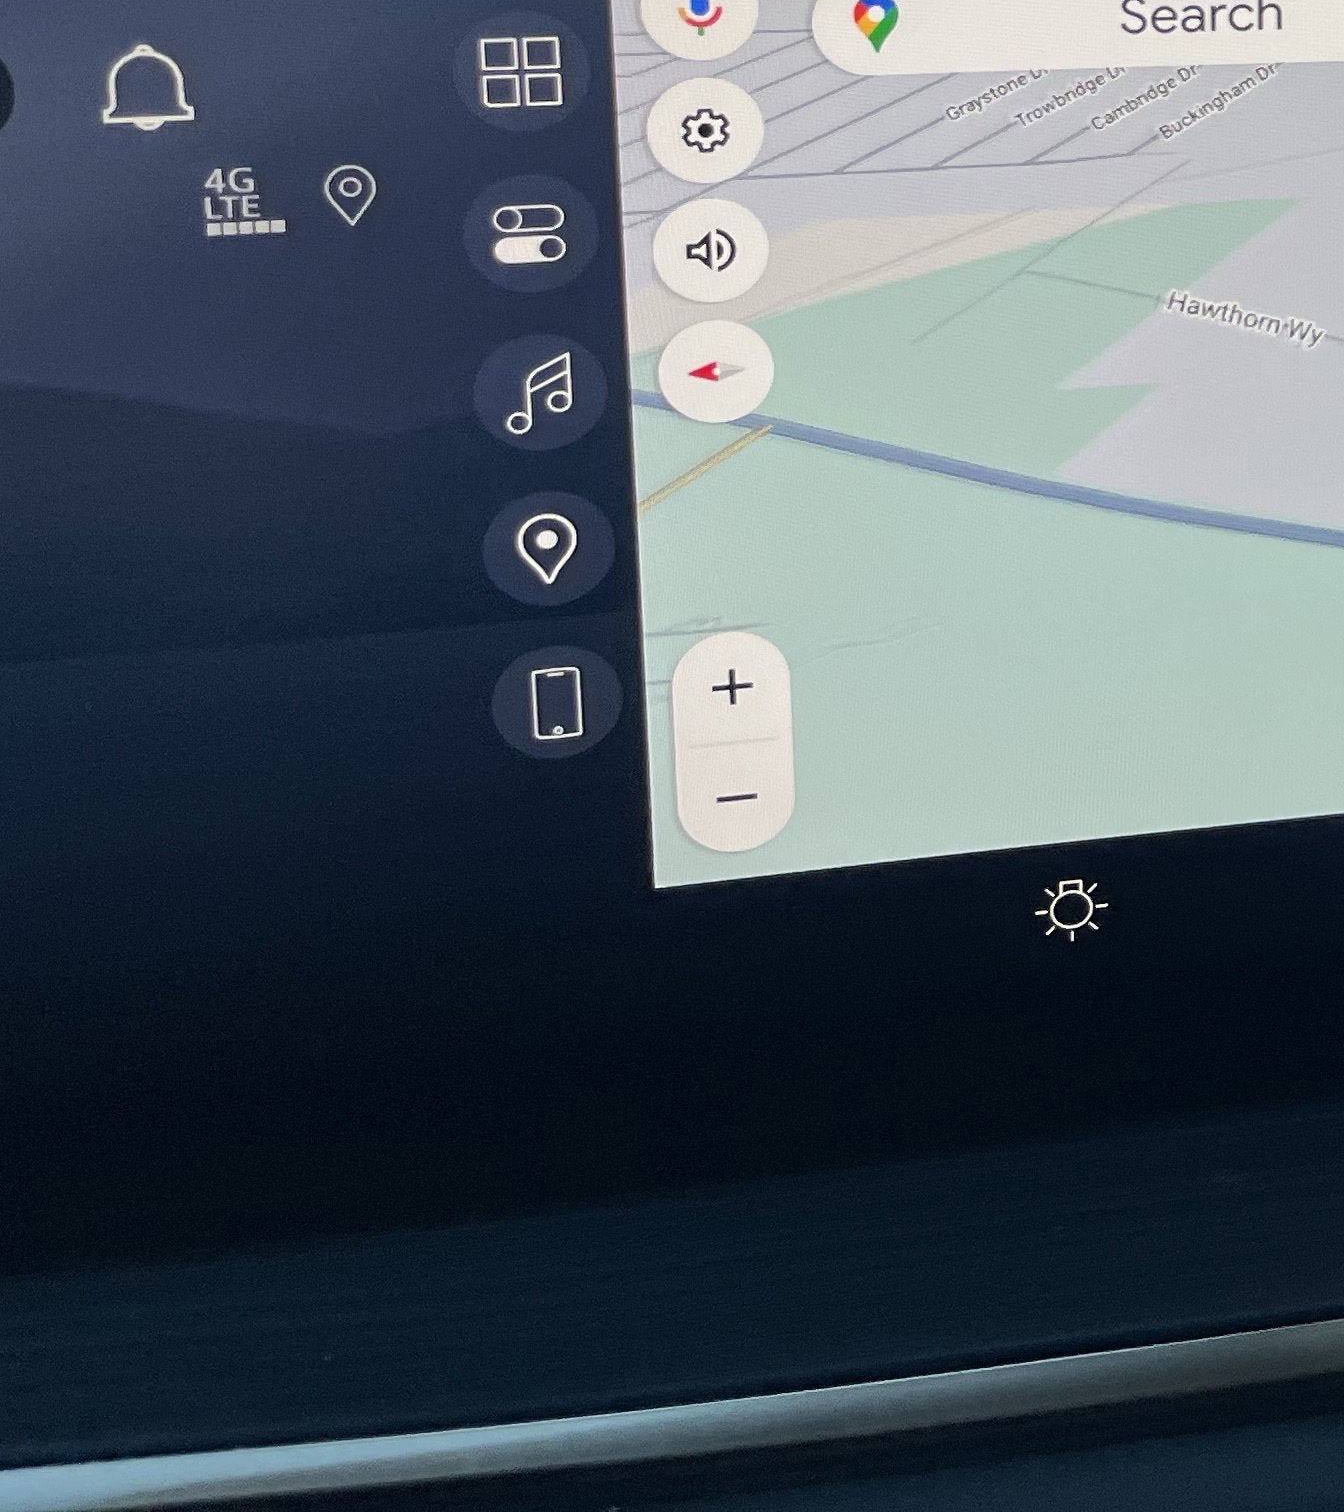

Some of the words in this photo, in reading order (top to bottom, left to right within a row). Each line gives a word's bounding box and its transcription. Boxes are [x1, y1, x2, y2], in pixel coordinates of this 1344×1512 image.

[945, 74, 1028, 122] Graystone
[1016, 74, 1106, 128] Trowbridge
[1090, 78, 1180, 131] Cambridge
[1158, 75, 1258, 140] Buckingham
[1256, 64, 1277, 83] Dr
[204, 194, 261, 220] LTE
[205, 167, 255, 194] 4G
[1166, 291, 1281, 335] Hawthorn
[1288, 317, 1323, 348] Wy
